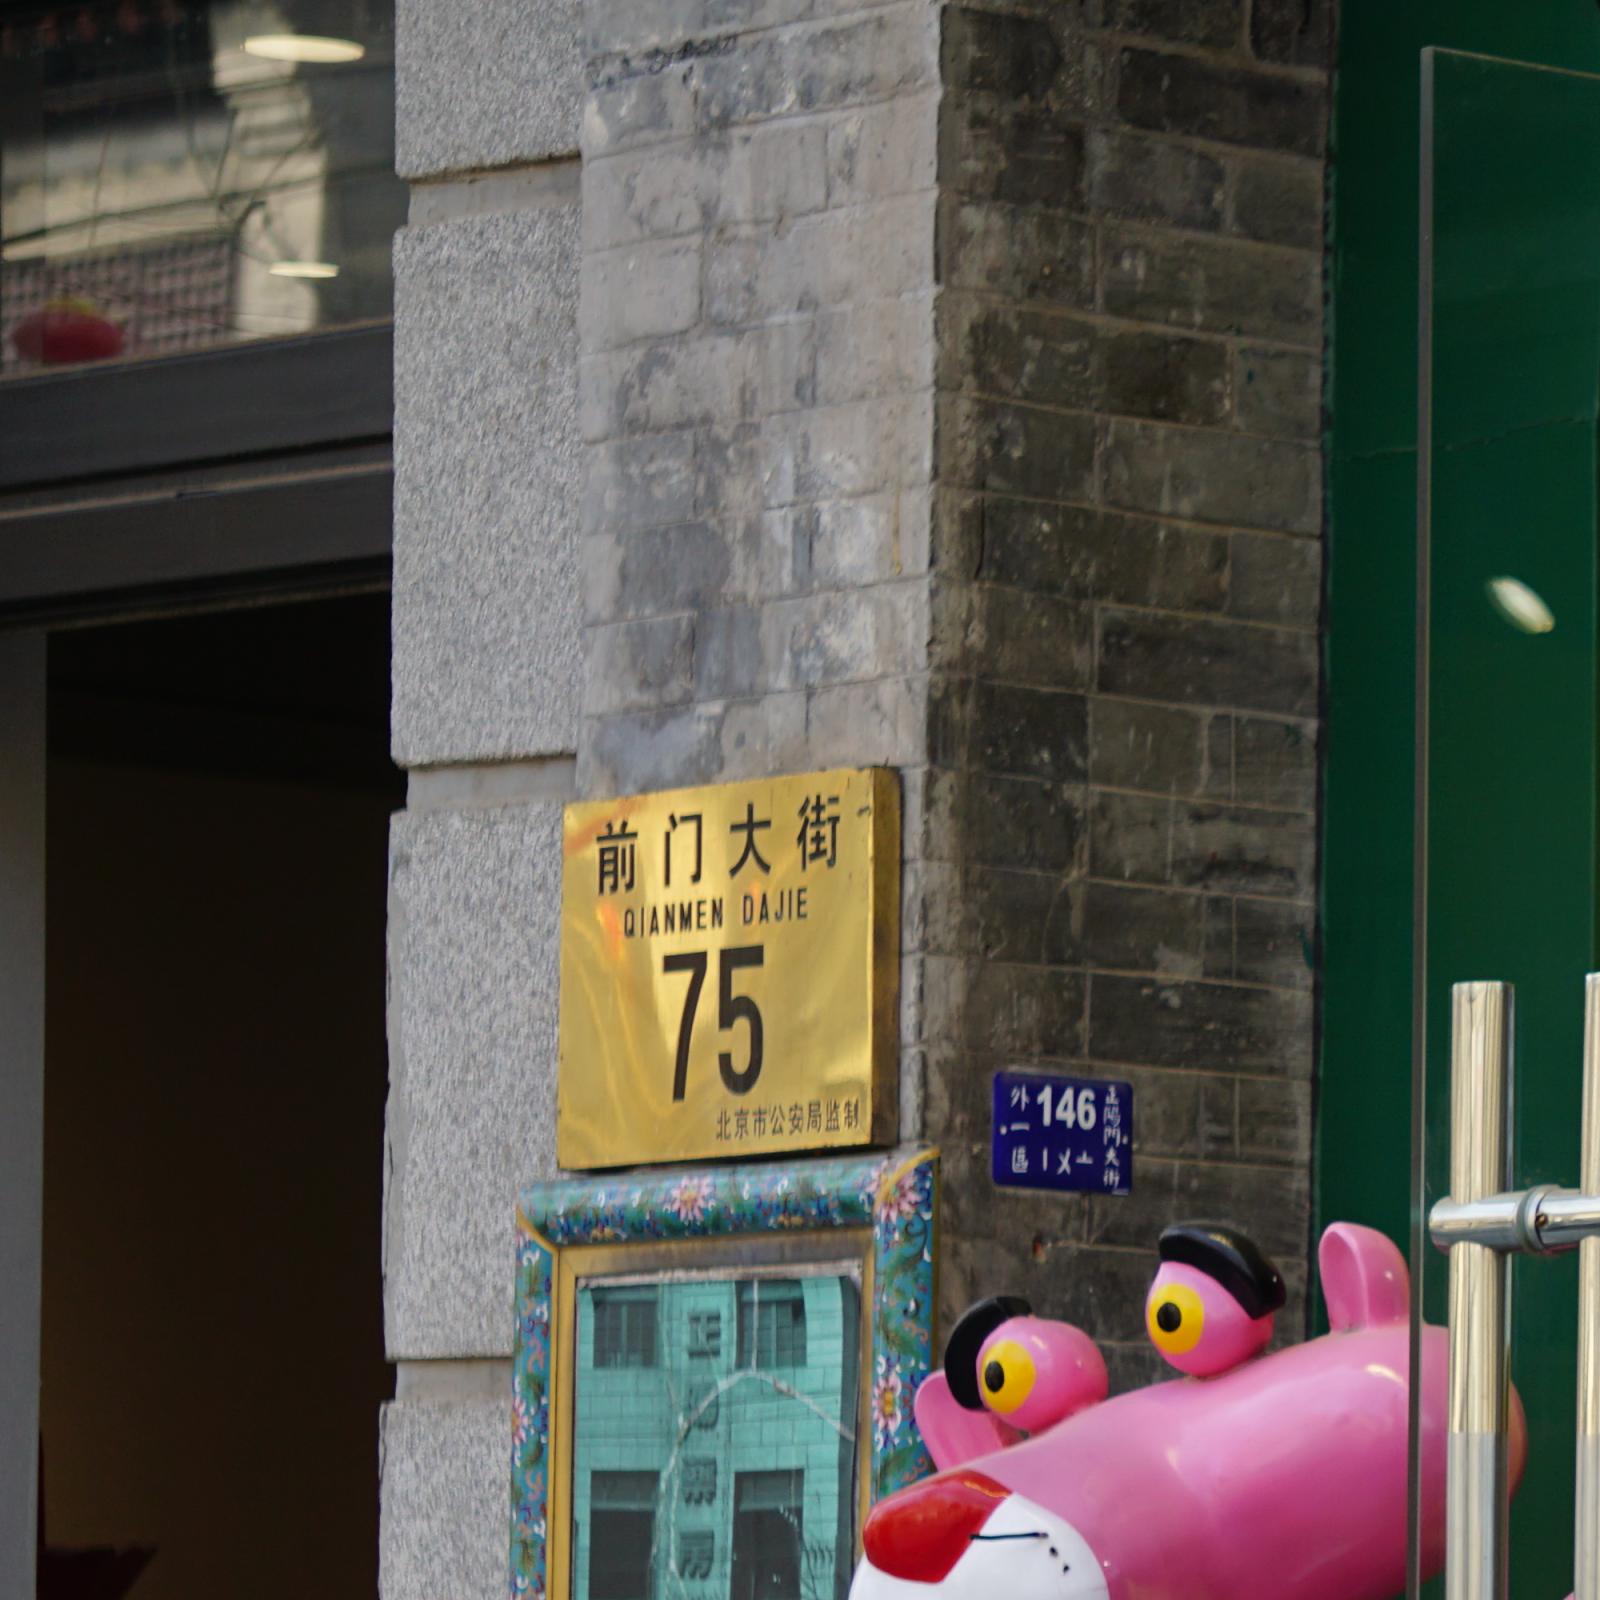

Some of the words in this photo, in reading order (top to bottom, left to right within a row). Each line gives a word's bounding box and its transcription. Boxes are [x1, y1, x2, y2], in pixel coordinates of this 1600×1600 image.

[597, 793, 840, 897] 前门大街
[623, 897, 724, 938] QIANMEN
[742, 886, 809, 925] DAJIE
[663, 945, 764, 1104] 75
[716, 1098, 860, 1143] 北京市公安局监制
[1036, 1084, 1097, 1130] 146
